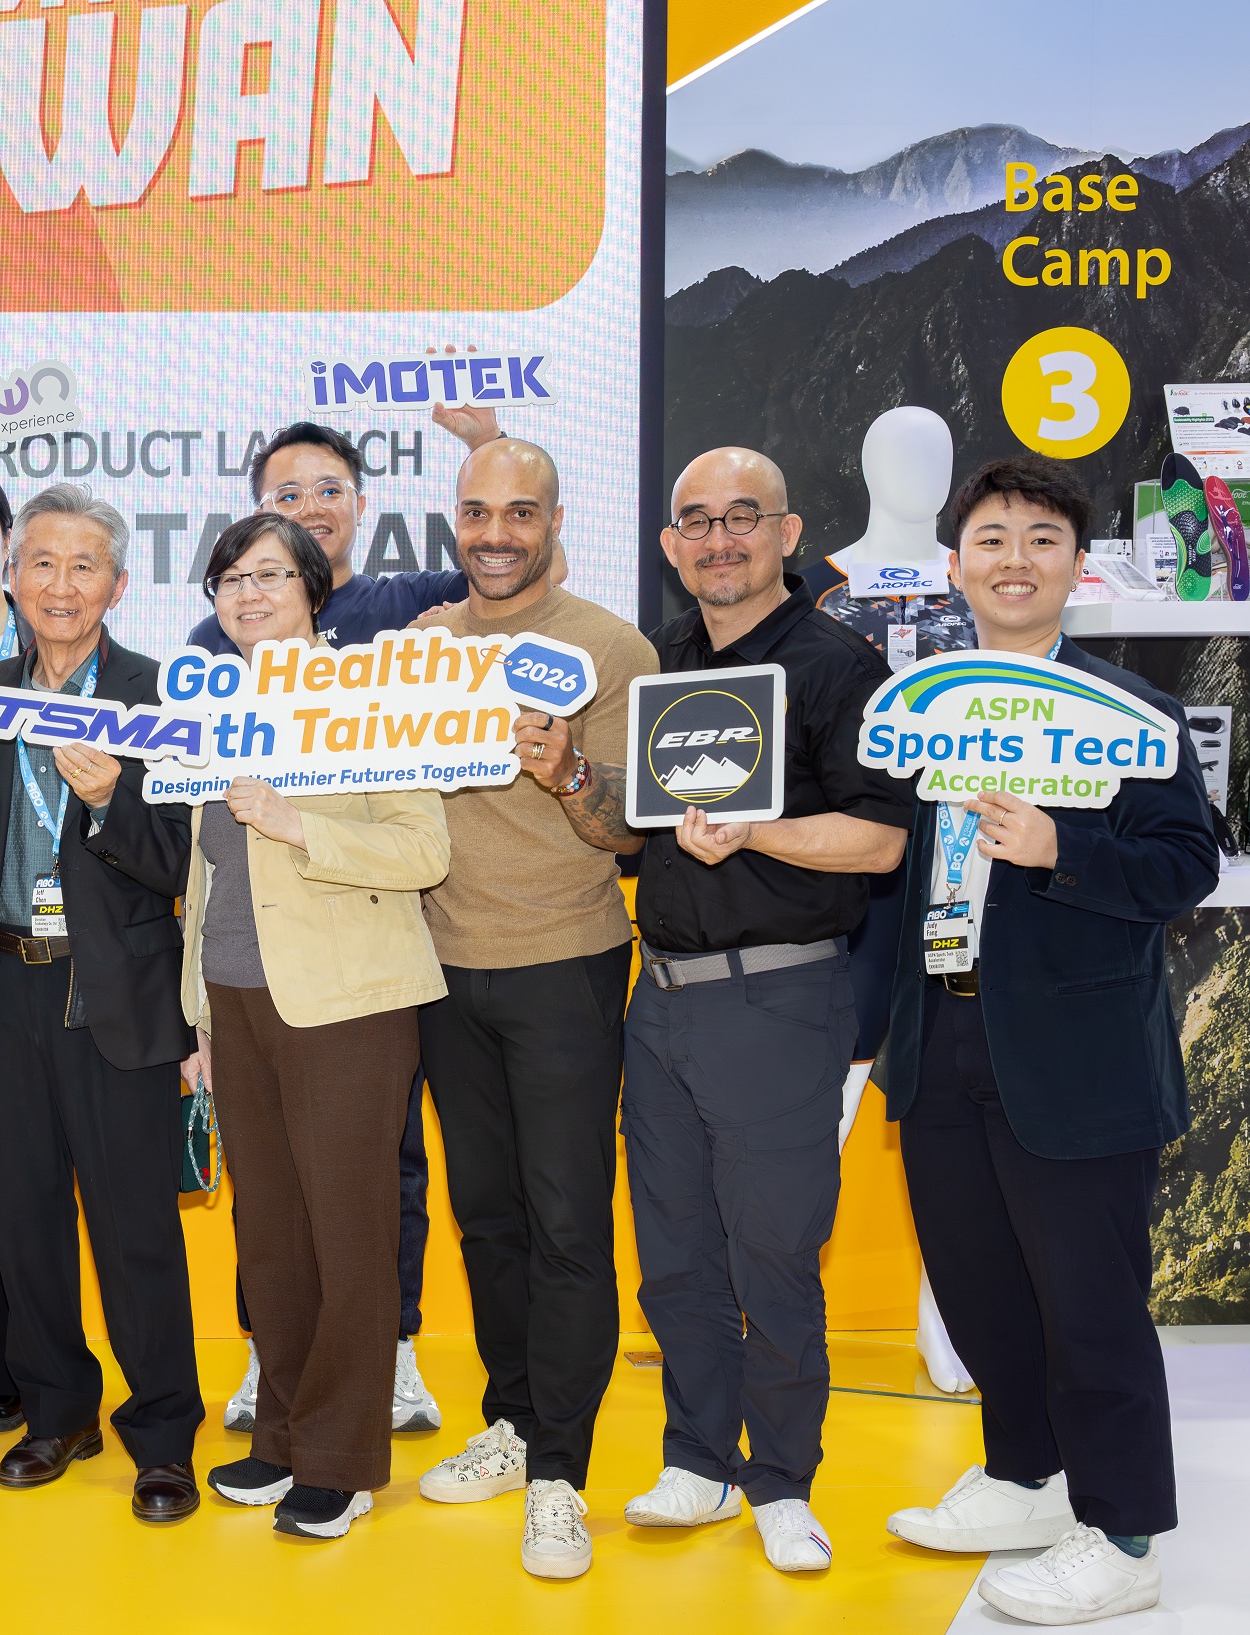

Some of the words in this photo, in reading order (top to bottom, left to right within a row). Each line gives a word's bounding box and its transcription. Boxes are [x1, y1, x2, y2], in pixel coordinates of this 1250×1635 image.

[1005, 161, 1139, 213] Base
[1002, 237, 1172, 299] Camp
[1037, 350, 1101, 441] 3
[867, 580, 933, 590] AROPEC
[166, 656, 241, 701] Go
[257, 636, 503, 695] Healthy
[512, 657, 579, 693] 2026
[964, 697, 1055, 722] ASPN
[293, 701, 510, 754] Taiwan
[655, 726, 761, 749] EBR
[867, 723, 1024, 768] Sports
[1043, 728, 1167, 768] Tech
[150, 777, 231, 796] Designin
[248, 770, 337, 788] ealthier
[340, 767, 417, 786] Futures
[421, 760, 511, 783] Together
[927, 769, 1108, 798] Accelerator
[26, 781, 44, 808] FIBO
[36, 879, 55, 888] FIBO
[39, 905, 64, 914] DHZ
[927, 910, 947, 920] FIBO
[932, 938, 960, 949] DHZ
